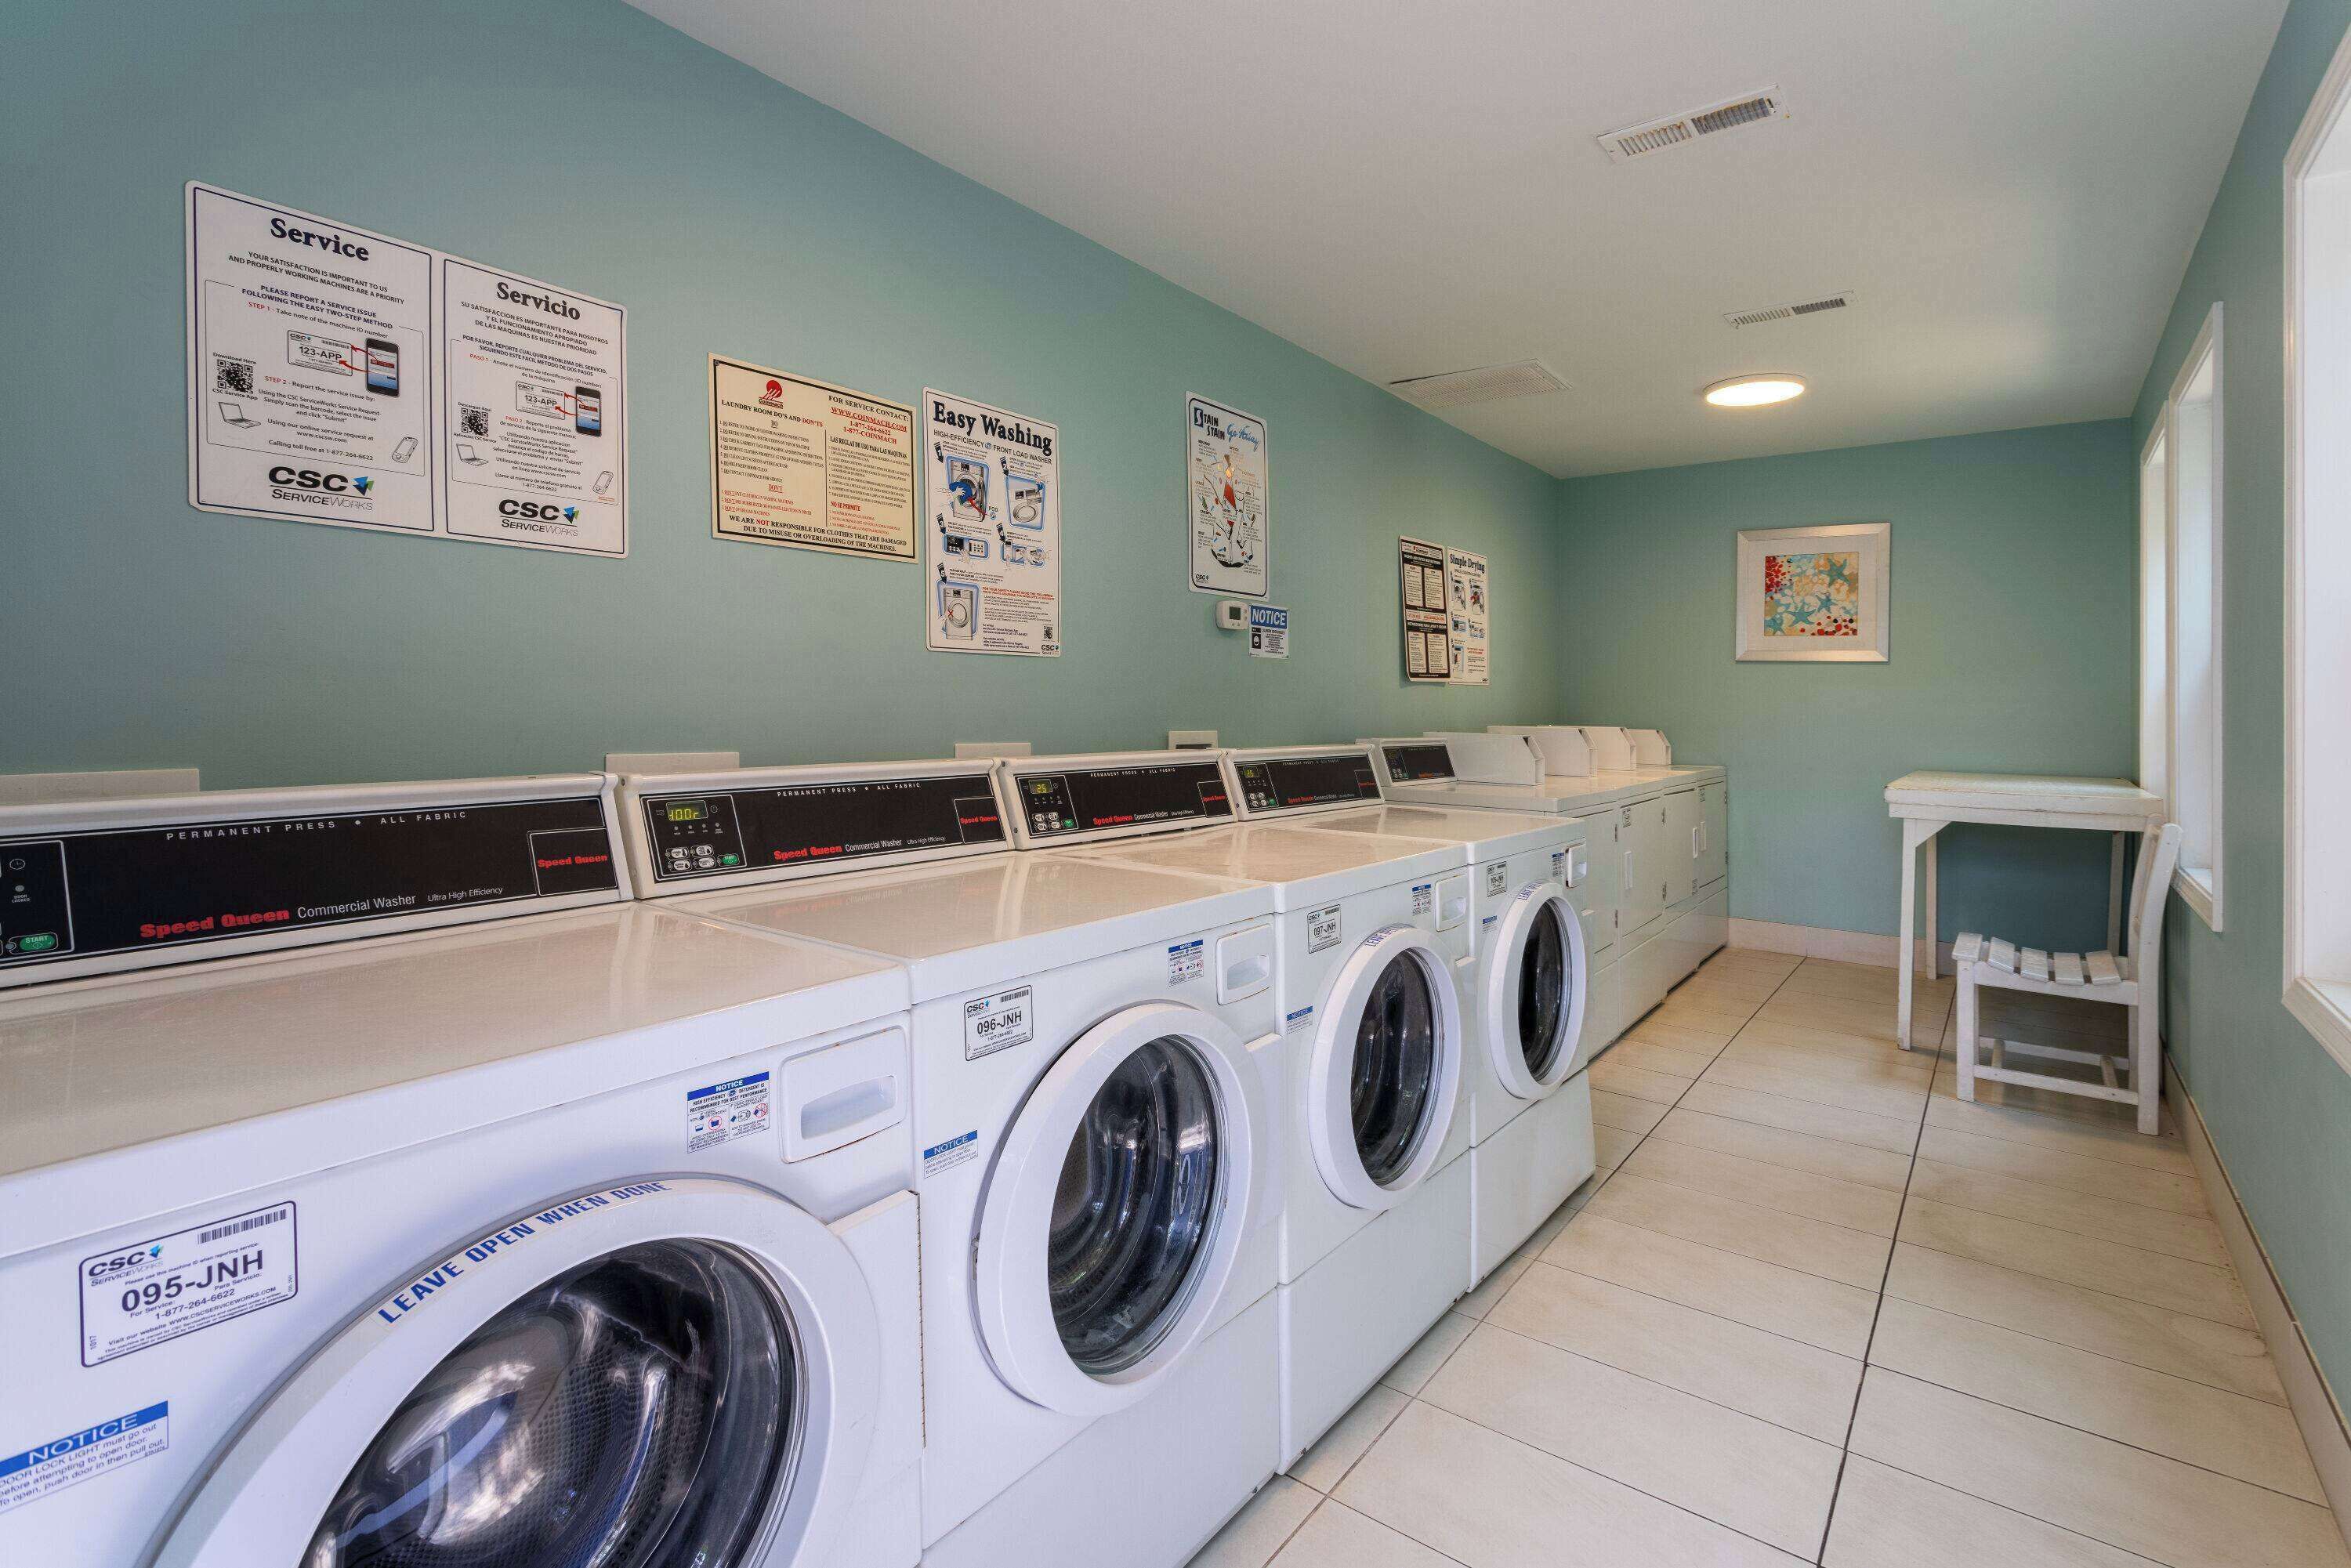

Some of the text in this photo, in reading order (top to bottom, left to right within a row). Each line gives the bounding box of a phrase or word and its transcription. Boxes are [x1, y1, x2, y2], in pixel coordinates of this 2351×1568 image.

[270, 216, 370, 262] Service
[229, 255, 245, 263] AND
[246, 259, 284, 273] PROPERLY
[284, 269, 319, 283] WORKING
[320, 278, 355, 292] MACHINES
[375, 292, 404, 304] PRIORITY
[248, 251, 269, 263] YOUR
[270, 257, 321, 275] SATISFACTION
[329, 273, 368, 287] IMPORTANT
[242, 288, 288, 304] FOLLOWING
[306, 304, 324, 313] EASY
[325, 309, 362, 321] TWO-STEP
[363, 317, 393, 329] METHOD
[261, 285, 289, 297] PLEASE
[290, 292, 319, 303] REPORT
[327, 301, 356, 313] SERVICE
[357, 309, 376, 318] ISSUE
[497, 282, 580, 320] Servicio
[470, 303, 516, 320] SATISFACCION
[524, 318, 562, 333] IMPORTANTE
[563, 328, 578, 337] PARA
[578, 333, 608, 345] NOSOTROS
[299, 346, 342, 360] 123-APP
[524, 394, 557, 407] 123-APP
[759, 398, 784, 408] Coinmach
[828, 395, 910, 422] FOR SERVICE CONTACT:
[721, 400, 752, 411] LAUNDRY
[753, 407, 773, 415] ROOM
[773, 410, 788, 419] DO'S
[802, 418, 823, 427] DON'TS
[831, 407, 907, 432] WWW.COINMACH.COM
[1194, 407, 1219, 428] STAIN
[843, 426, 897, 444] 1-877-COINMACH
[849, 421, 890, 436] 1-877-264-6622
[933, 401, 1052, 456] Easy Washing
[1207, 425, 1225, 440] STAIN
[933, 429, 984, 447] HIGH-EFFICIENCY
[993, 444, 1012, 454] FRONT
[1012, 450, 1028, 459] LOAD
[1029, 454, 1052, 465] WASHER
[268, 465, 348, 492] CSC
[498, 499, 560, 520] CSC
[768, 528, 793, 538] MISUSE
[802, 534, 846, 545] OVERLOADING
[868, 543, 897, 552] MACHINES.
[770, 521, 813, 532] RESPONSIBLE
[826, 529, 853, 538] CLOTHES
[881, 537, 907, 546] DAMAGED
[1450, 553, 1467, 567] Simple
[1467, 559, 1485, 574] Drying
[1251, 608, 1287, 627] NOTICE
[166, 826, 271, 840] PERMANENT
[284, 821, 335, 831] PRESS
[416, 811, 465, 821] FABRIC
[958, 813, 998, 826] Speed Queen
[1092, 816, 1113, 826] Speed
[773, 846, 842, 860] Speed Queen
[845, 838, 902, 852] Commercial Washer
[535, 855, 607, 871] Speed Queen
[446, 891, 466, 900] High
[466, 887, 503, 896] Efficiency
[298, 895, 416, 918] Commercial Washer
[140, 910, 290, 938] Speed Queen
[1313, 922, 1335, 936] 097-JNH
[25, 935, 49, 943] START
[967, 1003, 984, 1012] CSC
[977, 1011, 1022, 1034] 096-JNH
[716, 1080, 743, 1092] NOTICE
[690, 1102, 720, 1113] RECOMMENDED
[740, 1088, 767, 1099] PERFORMANCE
[934, 1135, 969, 1154] NOTICE
[89, 1251, 145, 1277] CSC
[378, 1182, 672, 1324] LEAVE OPEN WHEN DONE
[121, 1249, 263, 1312] 095-JNH
[214, 1273, 262, 1291] Para Servicio:
[129, 1301, 177, 1318] For Service:
[139, 1324, 167, 1335] website
[169, 1286, 276, 1325] WWW.CSCSERVICEWORKS.COM
[155, 1289, 235, 1320] 1-877-264-6622
[30, 1414, 138, 1465] NOTICE
[36, 1458, 65, 1474] LOCK
[69, 1447, 100, 1461] LIGHT
[103, 1436, 125, 1447] must
[128, 1432, 139, 1443] go
[143, 1423, 157, 1433] out
[13, 1487, 41, 1501] open,
[45, 1476, 69, 1490] push
[72, 1466, 93, 1478] door
[107, 1454, 128, 1465] then
[130, 1446, 147, 1458] pull
[149, 1439, 165, 1448] out.
[33, 1461, 85, 1484] attempting
[88, 1456, 97, 1465] to
[99, 1447, 124, 1464] open
[126, 1437, 147, 1450] door.
